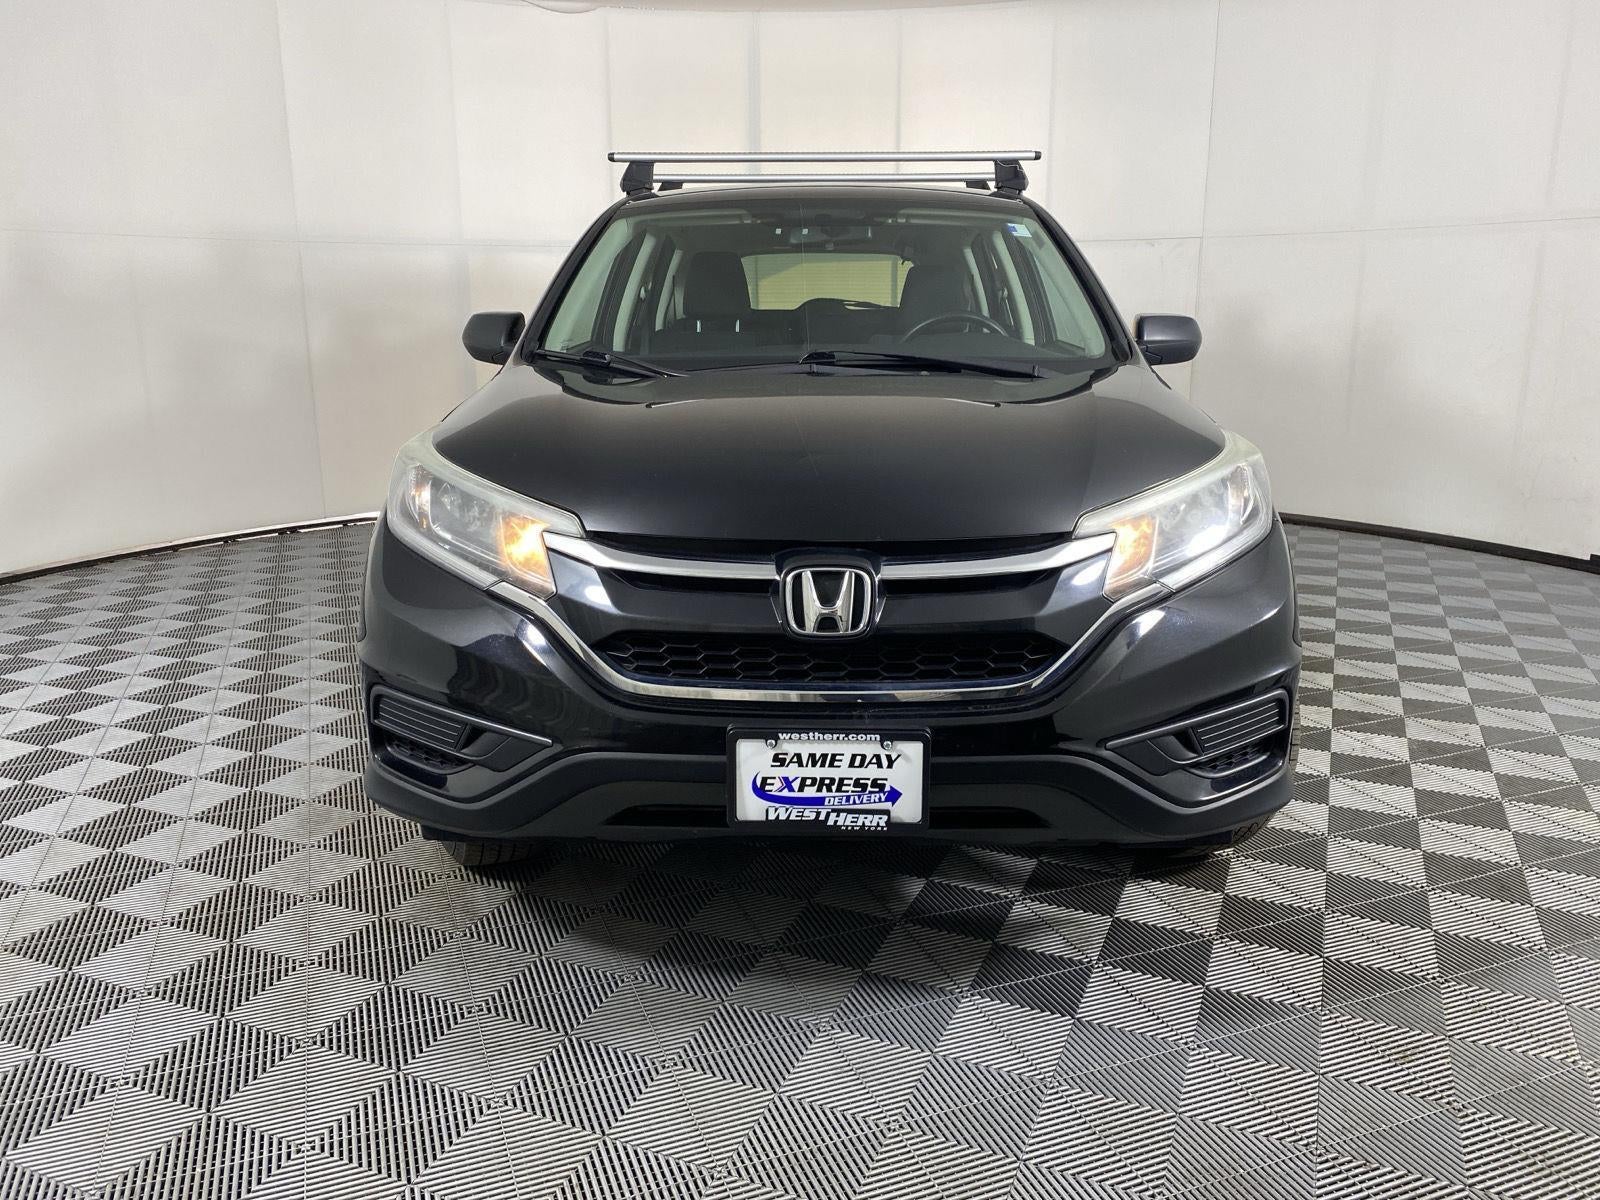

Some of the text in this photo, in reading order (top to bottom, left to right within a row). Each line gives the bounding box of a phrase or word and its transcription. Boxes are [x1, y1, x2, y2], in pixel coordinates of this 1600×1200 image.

[778, 732, 881, 741] westherr.com
[770, 752, 902, 769] SAME DAY
[759, 776, 888, 793] EXPRESS
[824, 792, 888, 806] DELIVERY
